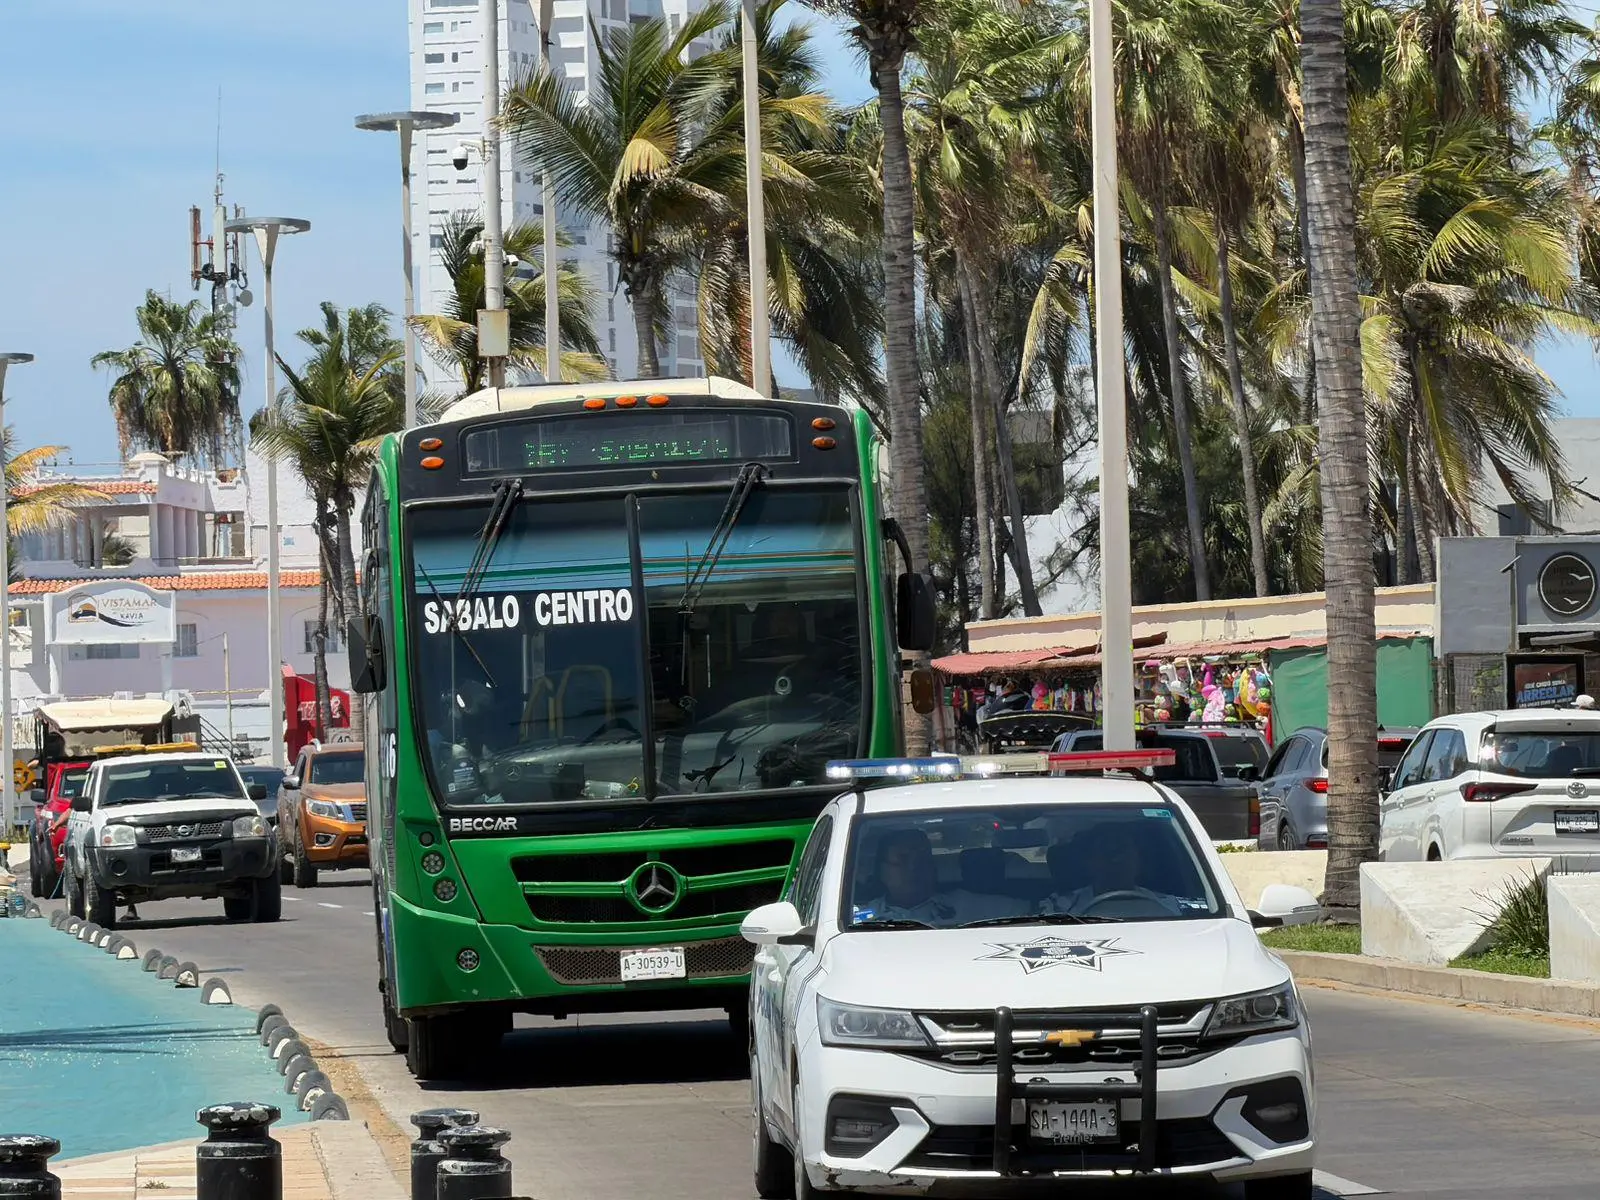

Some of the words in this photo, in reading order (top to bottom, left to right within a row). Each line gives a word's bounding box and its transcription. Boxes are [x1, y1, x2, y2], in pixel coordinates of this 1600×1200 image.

[101, 598, 158, 608] VISTAMAR
[424, 594, 520, 634] SABALO
[534, 588, 633, 626] CENTRO
[449, 816, 518, 832] BECCAR
[623, 955, 683, 971] A-30539-U
[1031, 1108, 1117, 1130] SA-144A-3
